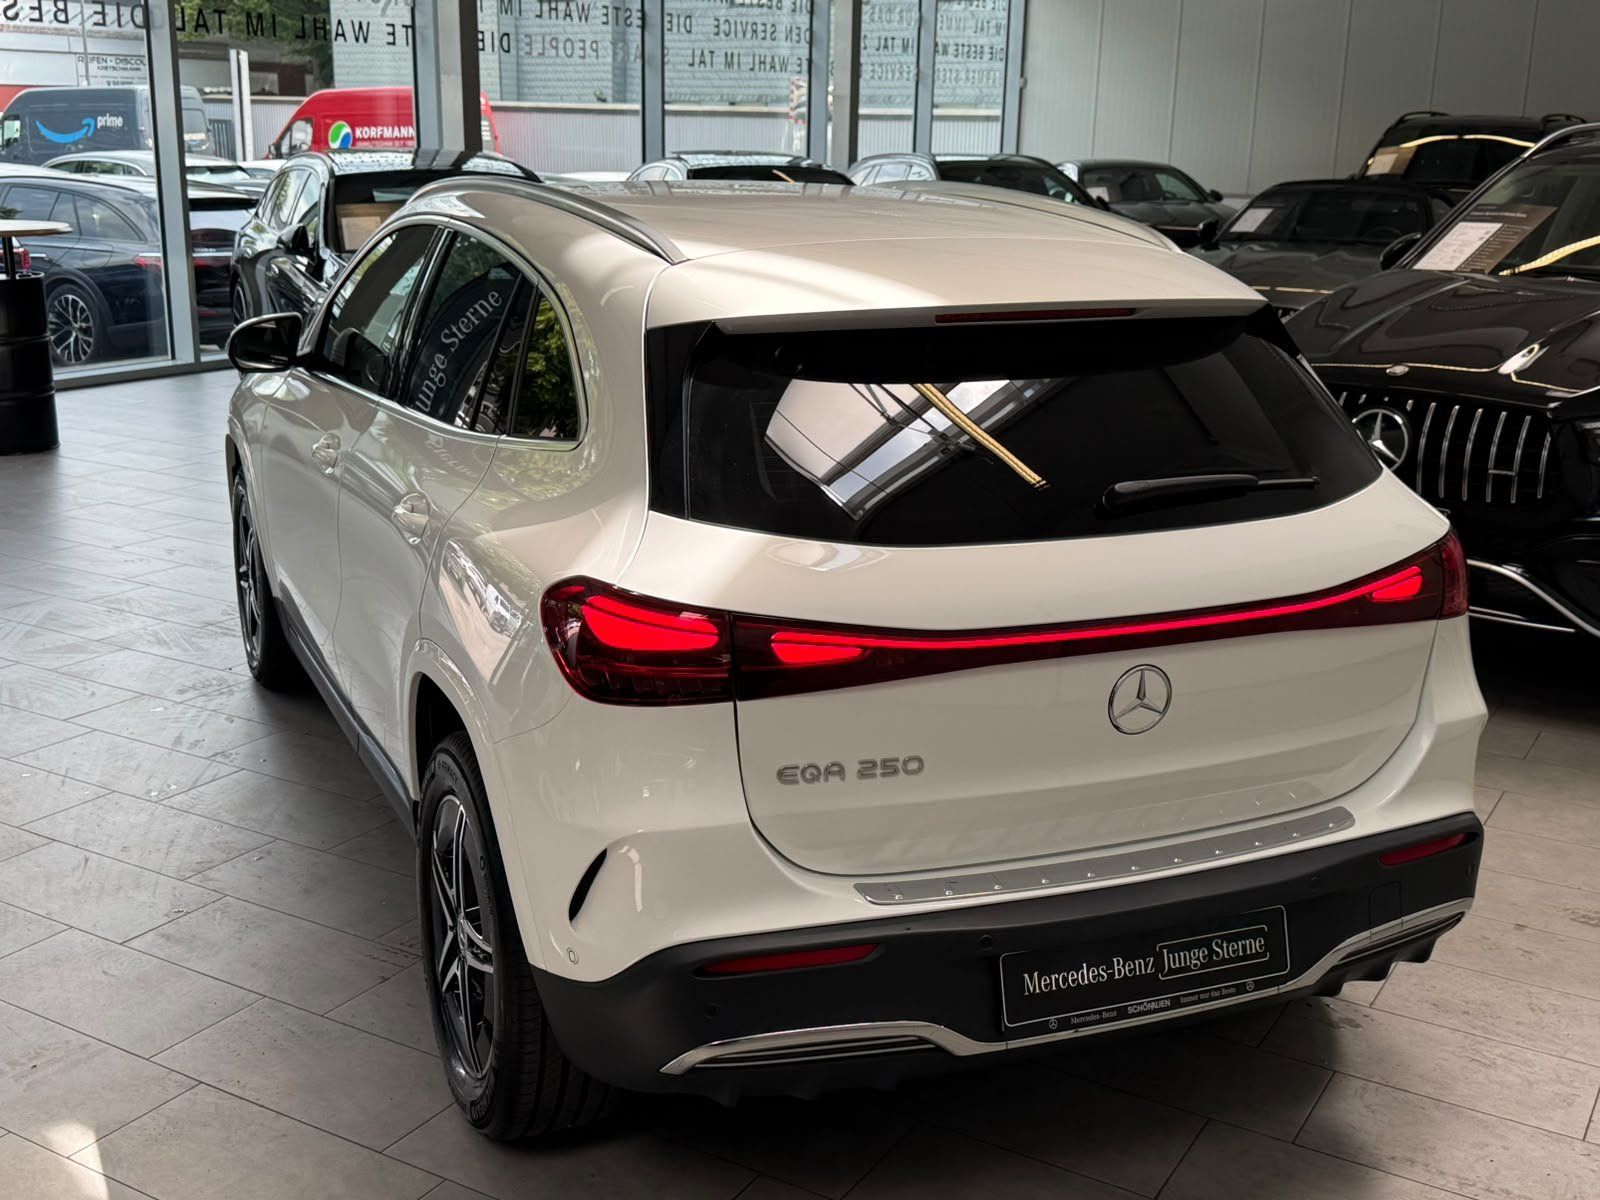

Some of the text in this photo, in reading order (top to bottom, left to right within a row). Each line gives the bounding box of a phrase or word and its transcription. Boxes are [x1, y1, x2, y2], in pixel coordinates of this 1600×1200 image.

[78, 56, 108, 64] RIFEN
[97, 113, 124, 129] prime
[440, 289, 502, 351] Sterne
[776, 755, 925, 785] EQA 250
[1023, 935, 1266, 996] Mercedes-Benz Junge Sterne
[1070, 1009, 1118, 1025] Mercedes-Benz
